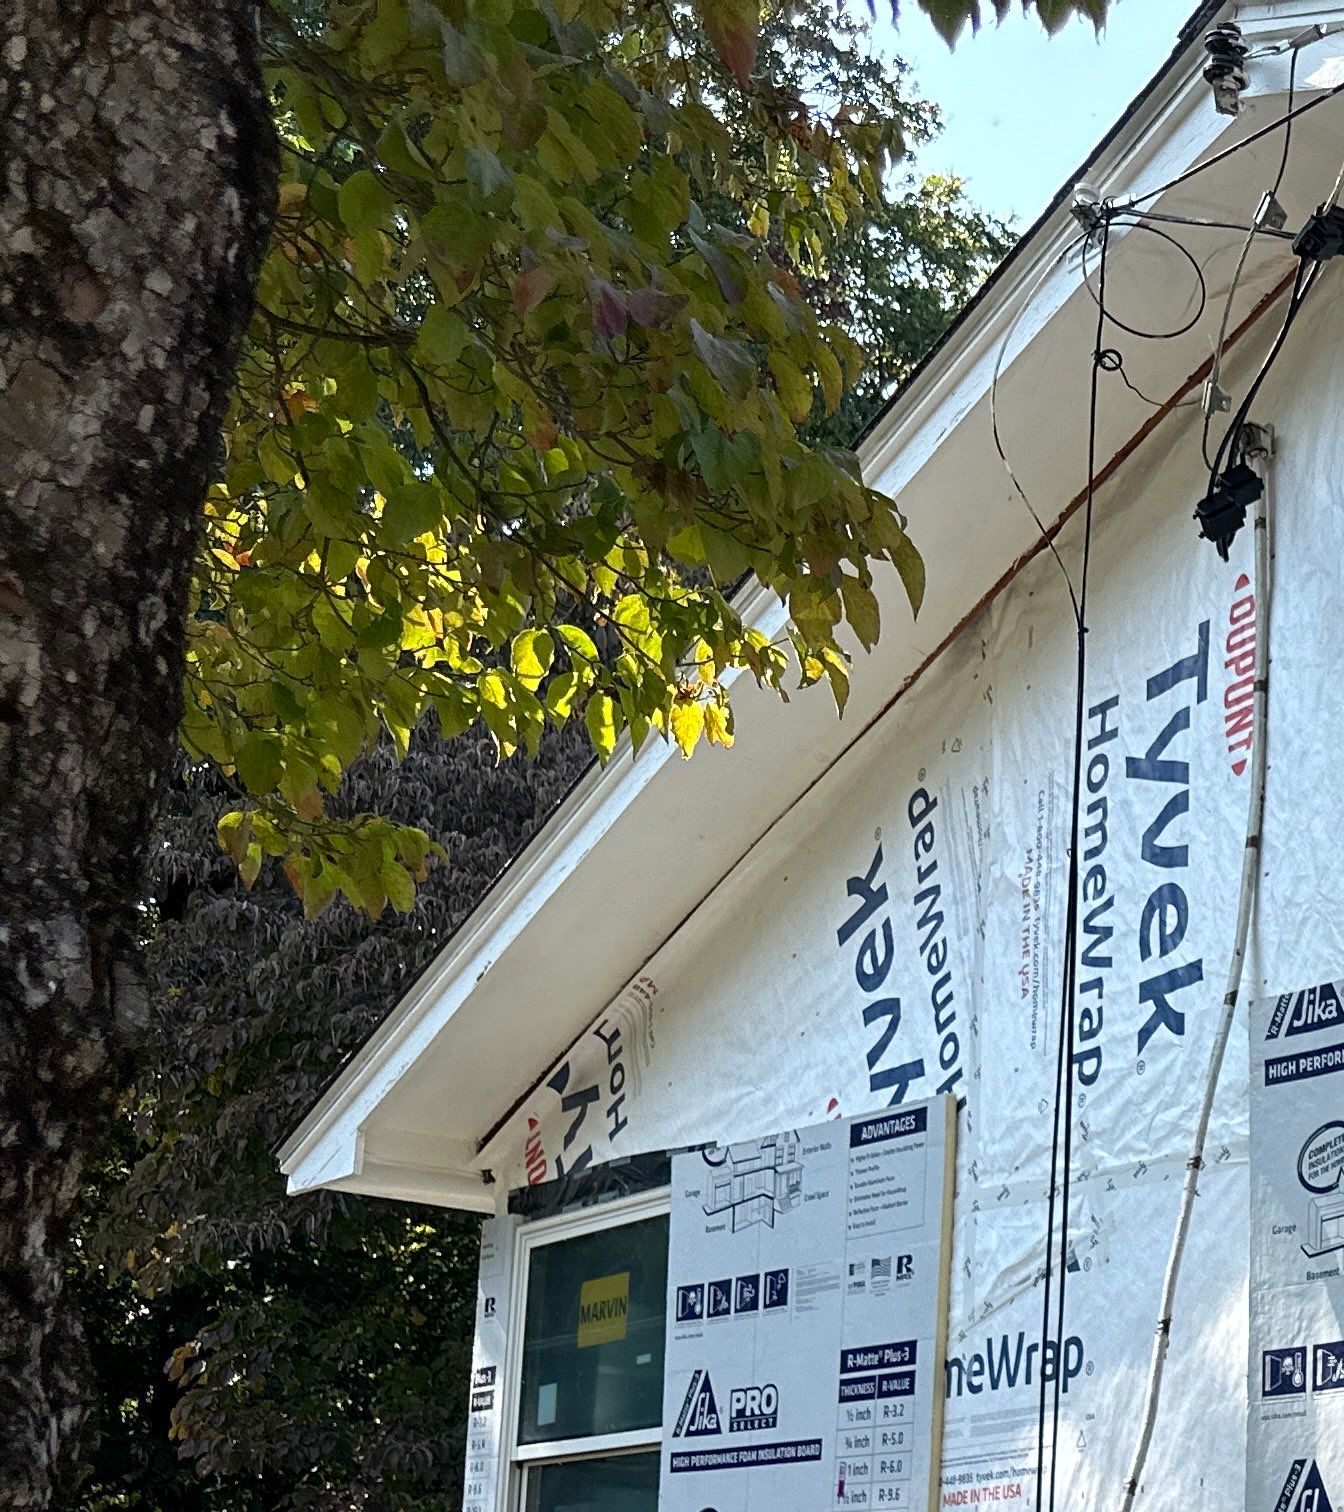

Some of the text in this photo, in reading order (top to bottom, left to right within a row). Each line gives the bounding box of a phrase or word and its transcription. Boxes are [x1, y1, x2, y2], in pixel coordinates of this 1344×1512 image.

[1226, 594, 1256, 753] DUPONT
[1269, 1059, 1297, 1079] HIGH
[860, 1114, 917, 1141] ADVANTAGES
[580, 1295, 628, 1327] MARVIN
[730, 1385, 778, 1417] PRO
[970, 1487, 981, 1503] IN
[982, 1486, 1000, 1502] THE
[1003, 1483, 1021, 1499] USA
